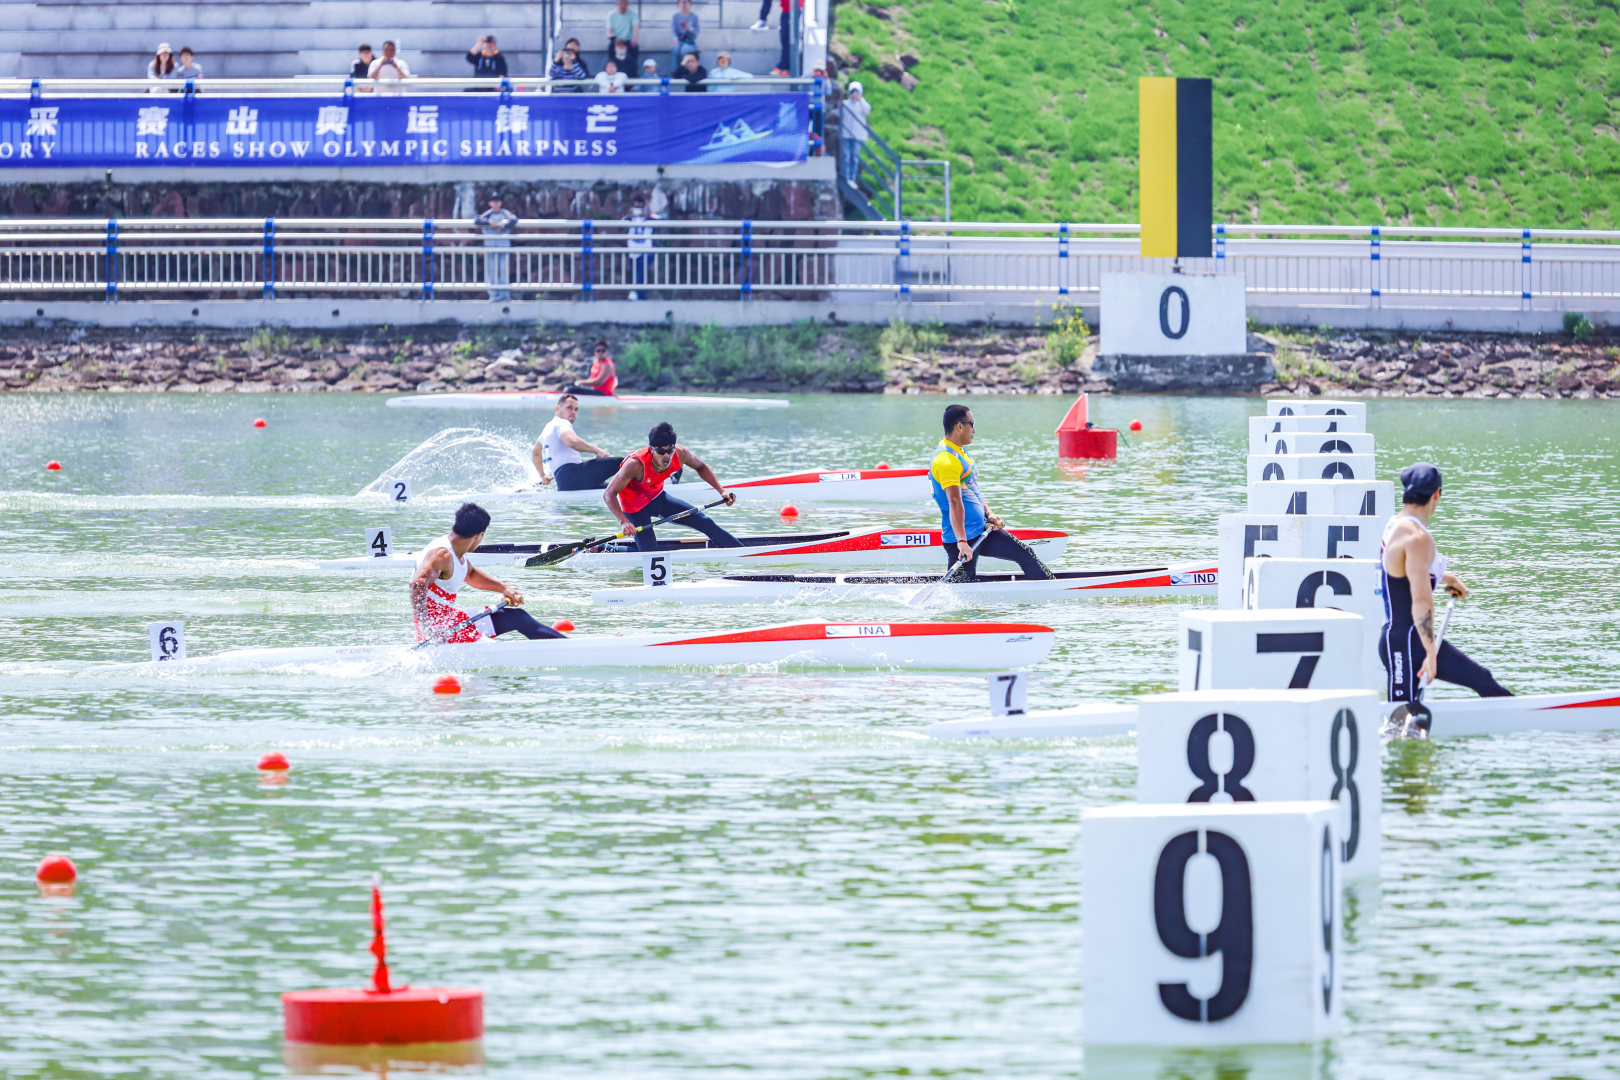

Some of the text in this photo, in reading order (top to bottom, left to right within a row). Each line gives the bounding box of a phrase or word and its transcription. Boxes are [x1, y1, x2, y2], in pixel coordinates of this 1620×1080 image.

[26, 106, 60, 136] 采
[135, 141, 220, 159] RACES
[233, 140, 311, 158] SHOW
[323, 139, 448, 158] OLYMPIC
[460, 139, 618, 157] SHARPNESS
[1159, 286, 1190, 339] 0
[394, 482, 407, 500] 2
[372, 531, 388, 552] 4
[905, 535, 926, 544] PHI
[651, 557, 666, 580] 5
[1193, 573, 1216, 583] IND
[159, 627, 178, 654] 6
[858, 626, 885, 634] INA
[997, 675, 1017, 707] 7
[1153, 829, 1253, 1023] 9
[1321, 823, 1334, 1016] 9
